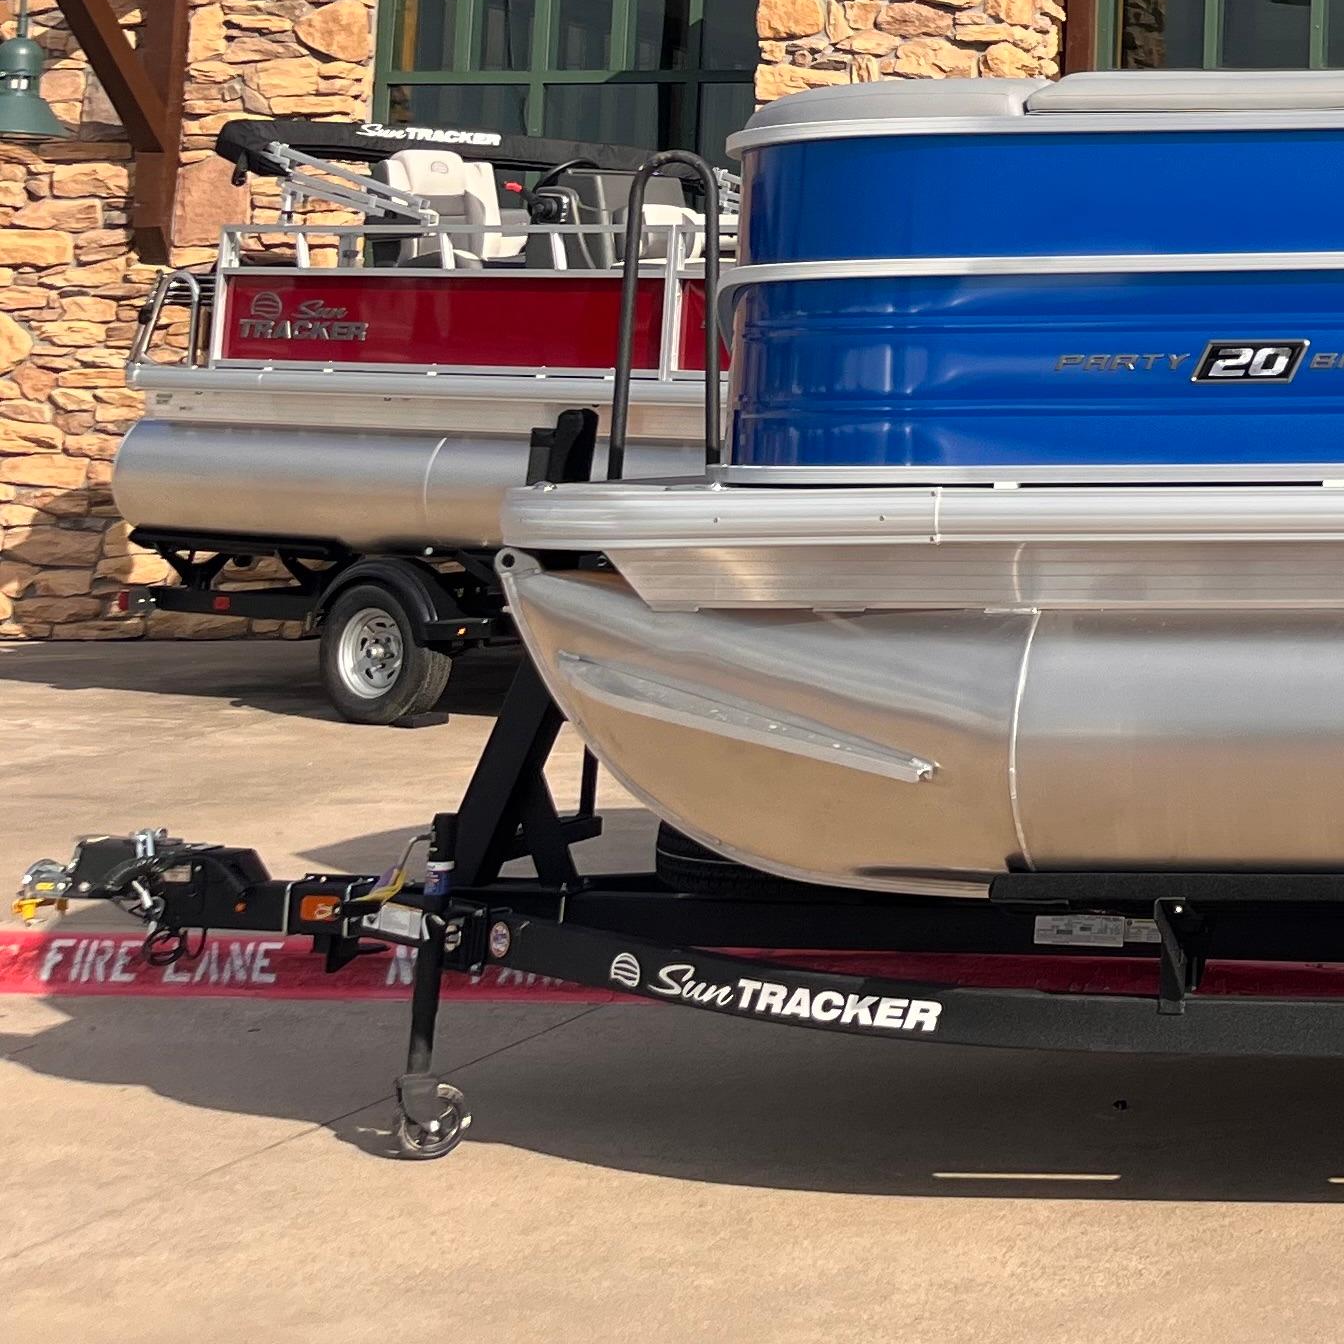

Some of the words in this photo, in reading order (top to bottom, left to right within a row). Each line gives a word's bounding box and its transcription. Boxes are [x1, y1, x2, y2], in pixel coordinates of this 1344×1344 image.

[406, 127, 502, 147] TRACKER
[291, 299, 349, 319] Sun
[239, 318, 369, 341] TRACKER
[1054, 353, 1190, 371] PARTY
[1208, 347, 1293, 377] 20
[39, 938, 146, 984] FIRE
[162, 940, 286, 984] LANE
[647, 964, 735, 1007] Sun
[737, 977, 944, 1033] TRACKER
